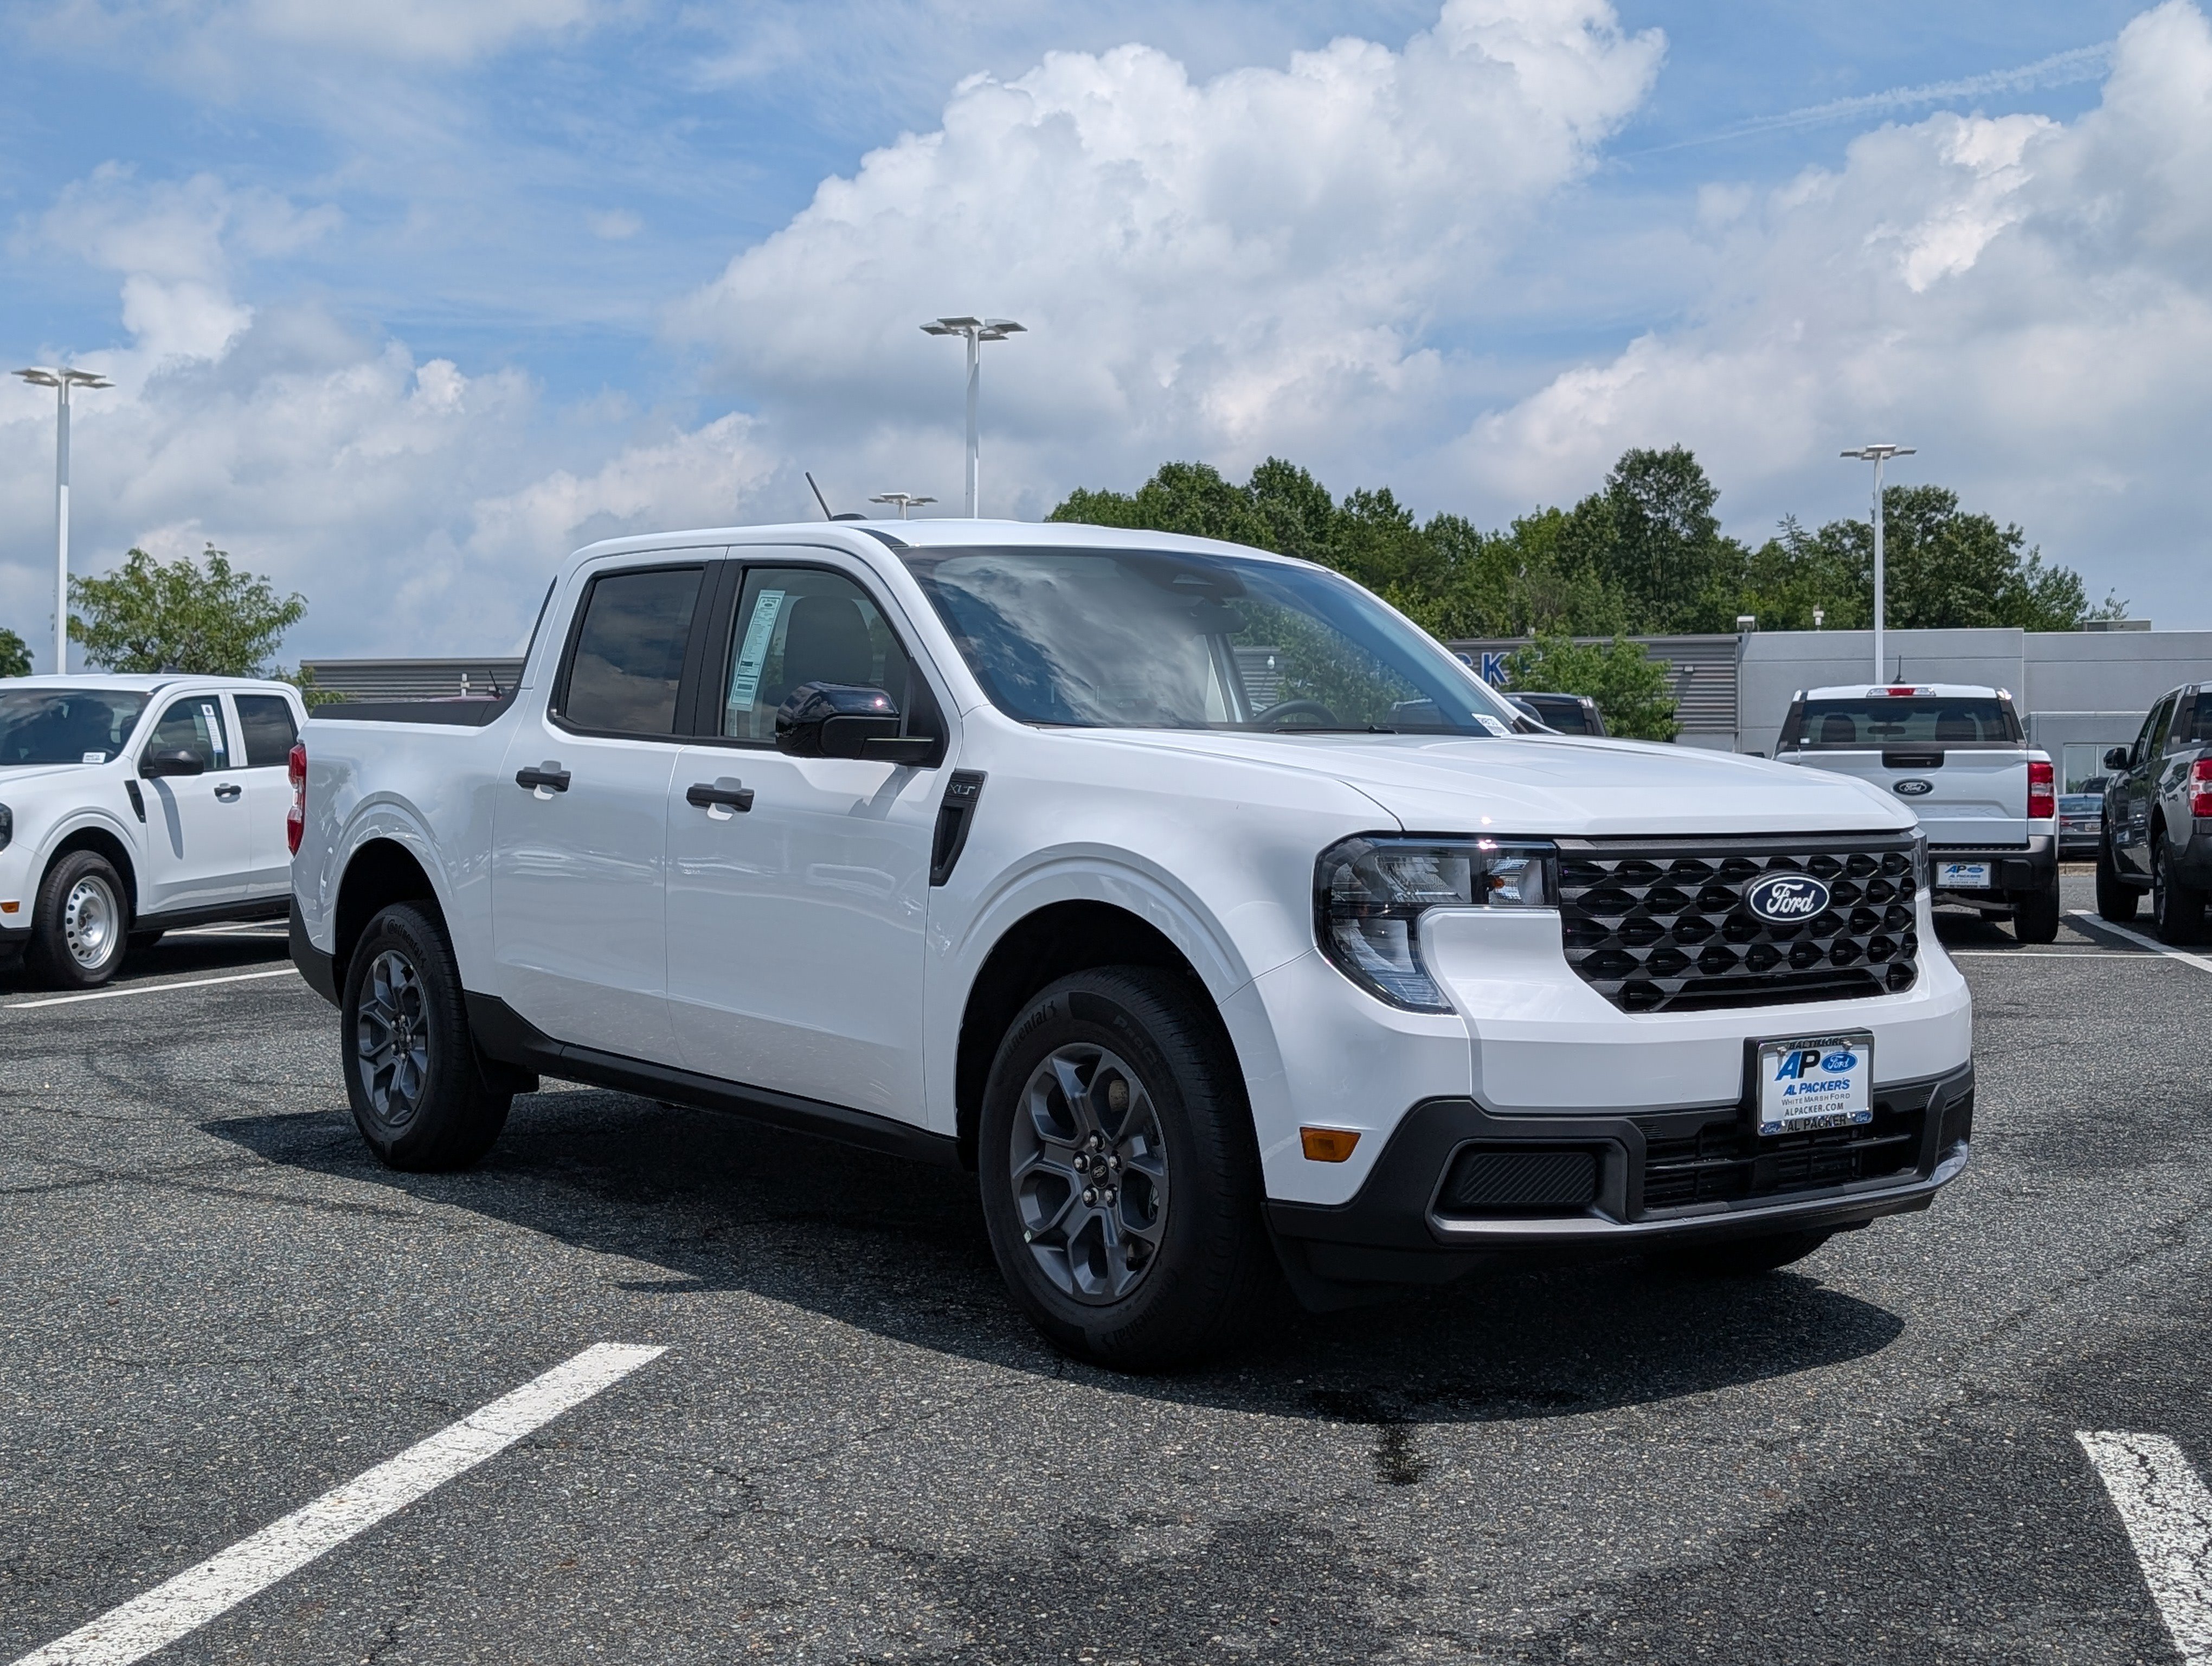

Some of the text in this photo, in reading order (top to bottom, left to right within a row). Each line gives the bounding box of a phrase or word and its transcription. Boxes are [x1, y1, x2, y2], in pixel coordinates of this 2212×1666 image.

[947, 784, 975, 795] XLT
[1945, 865, 1966, 874] AP
[1766, 883, 1816, 914] Ford
[387, 919, 423, 959] Continental
[1774, 1050, 1821, 1081] AP
[1783, 1078, 1851, 1097] AL PACKER'S
[1781, 1097, 1803, 1106] WHITE
[1804, 1094, 1829, 1103] MARSH
[1784, 1102, 1844, 1117] ALPACKER.COM
[1787, 1121, 1800, 1132] AL
[1804, 1114, 1847, 1129] PACKER
